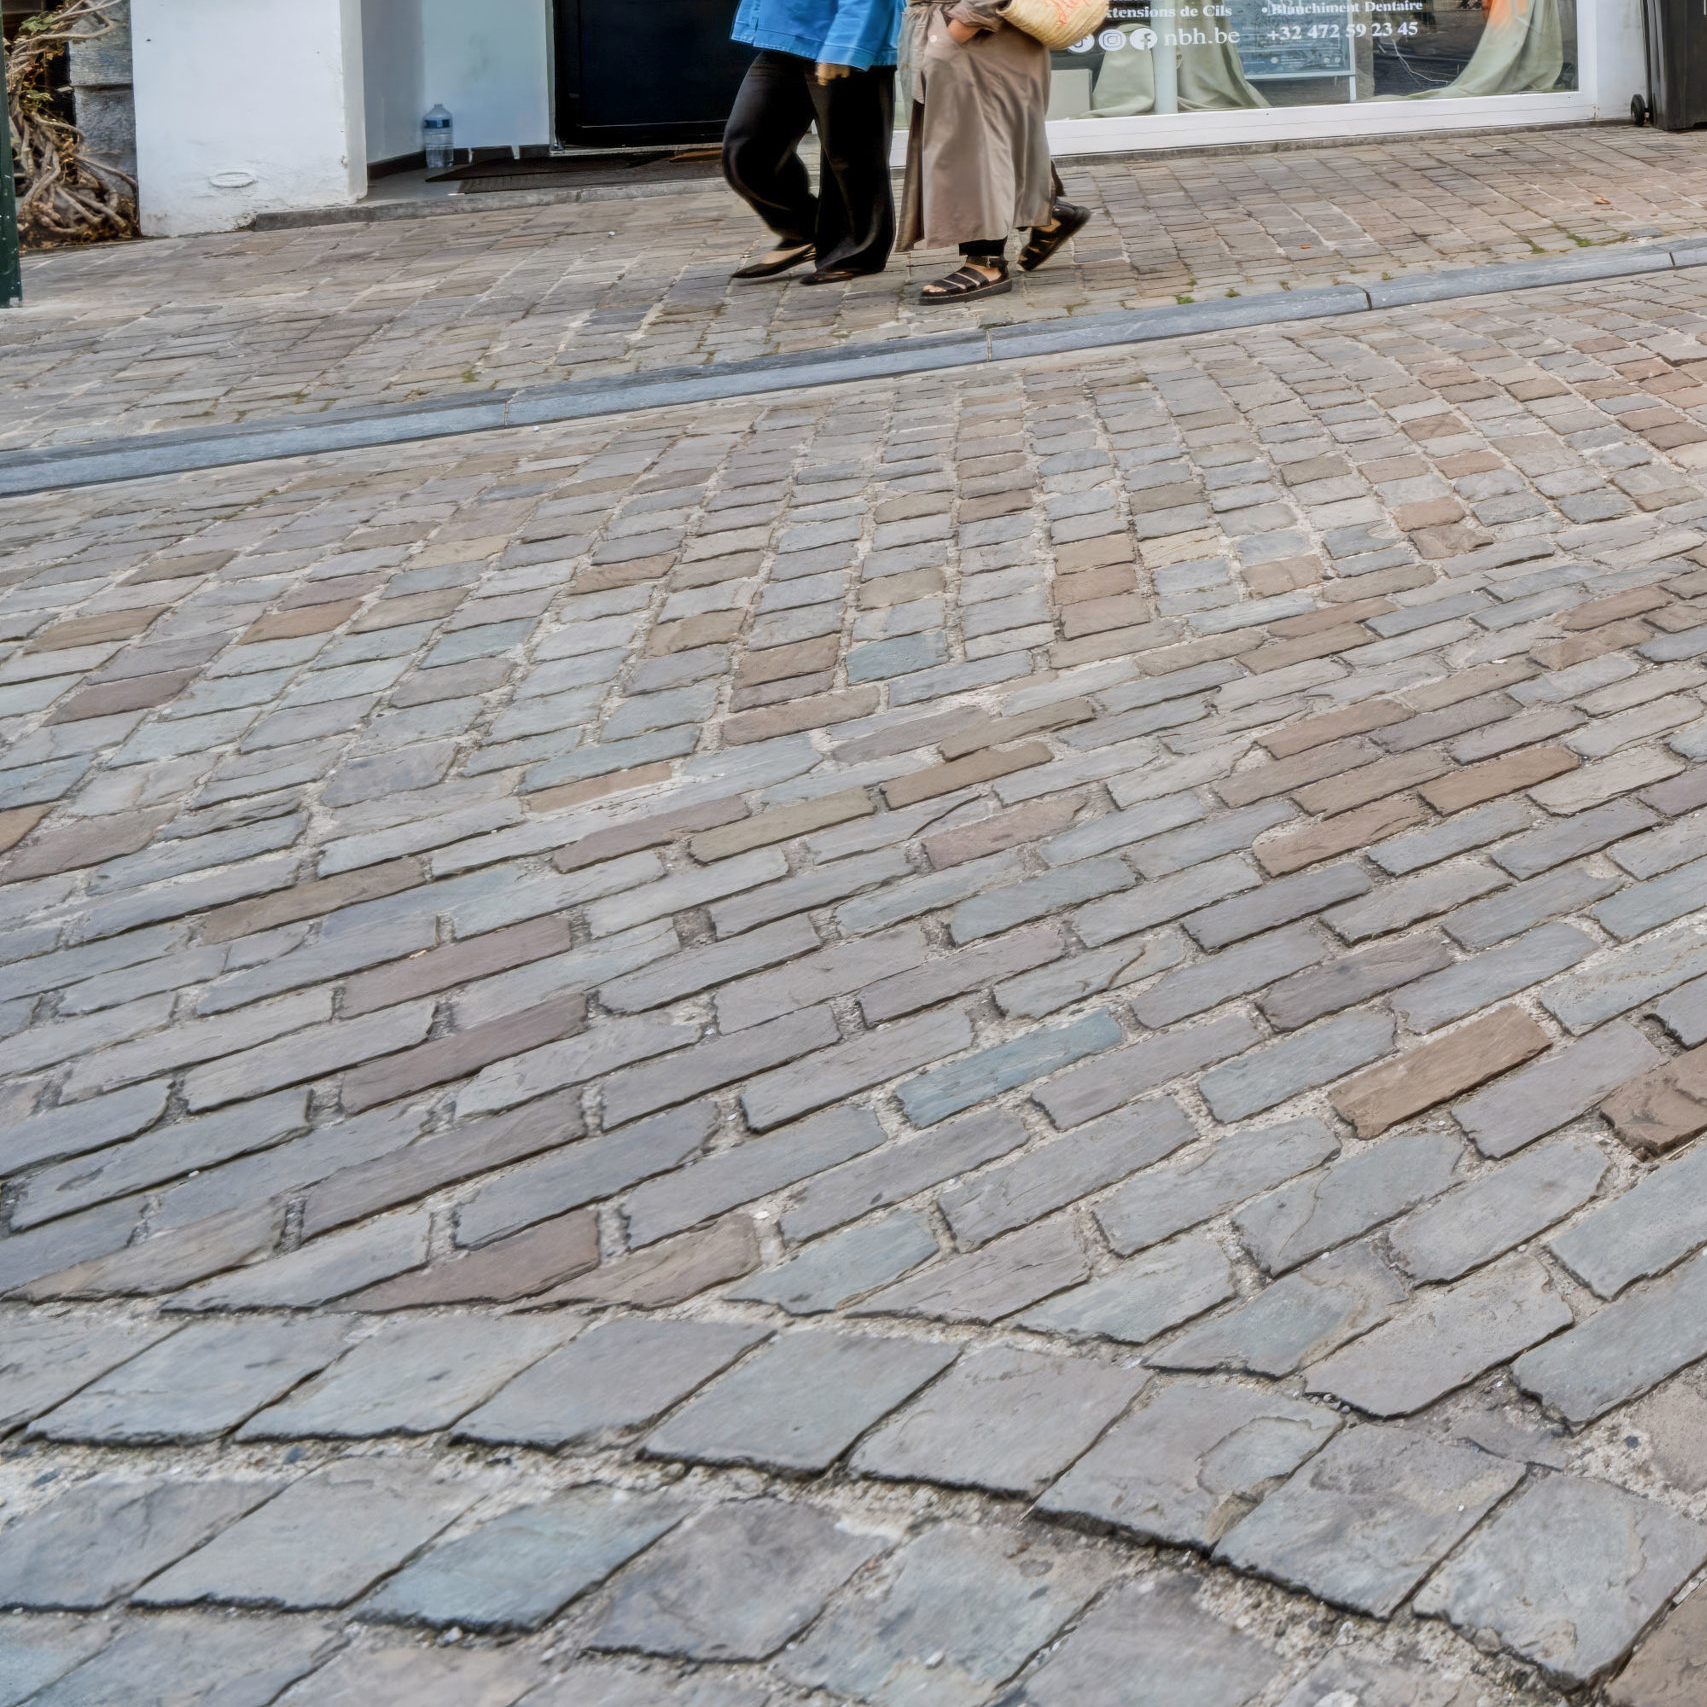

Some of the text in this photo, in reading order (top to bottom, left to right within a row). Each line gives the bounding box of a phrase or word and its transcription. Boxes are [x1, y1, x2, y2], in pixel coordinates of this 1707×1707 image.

[1107, 4, 1233, 18] xtensions de Cils
[1364, 0, 1423, 13] Dentaire
[1164, 27, 1241, 46] nbh.be
[1267, 21, 1419, 41] +32 472 59 23 45
